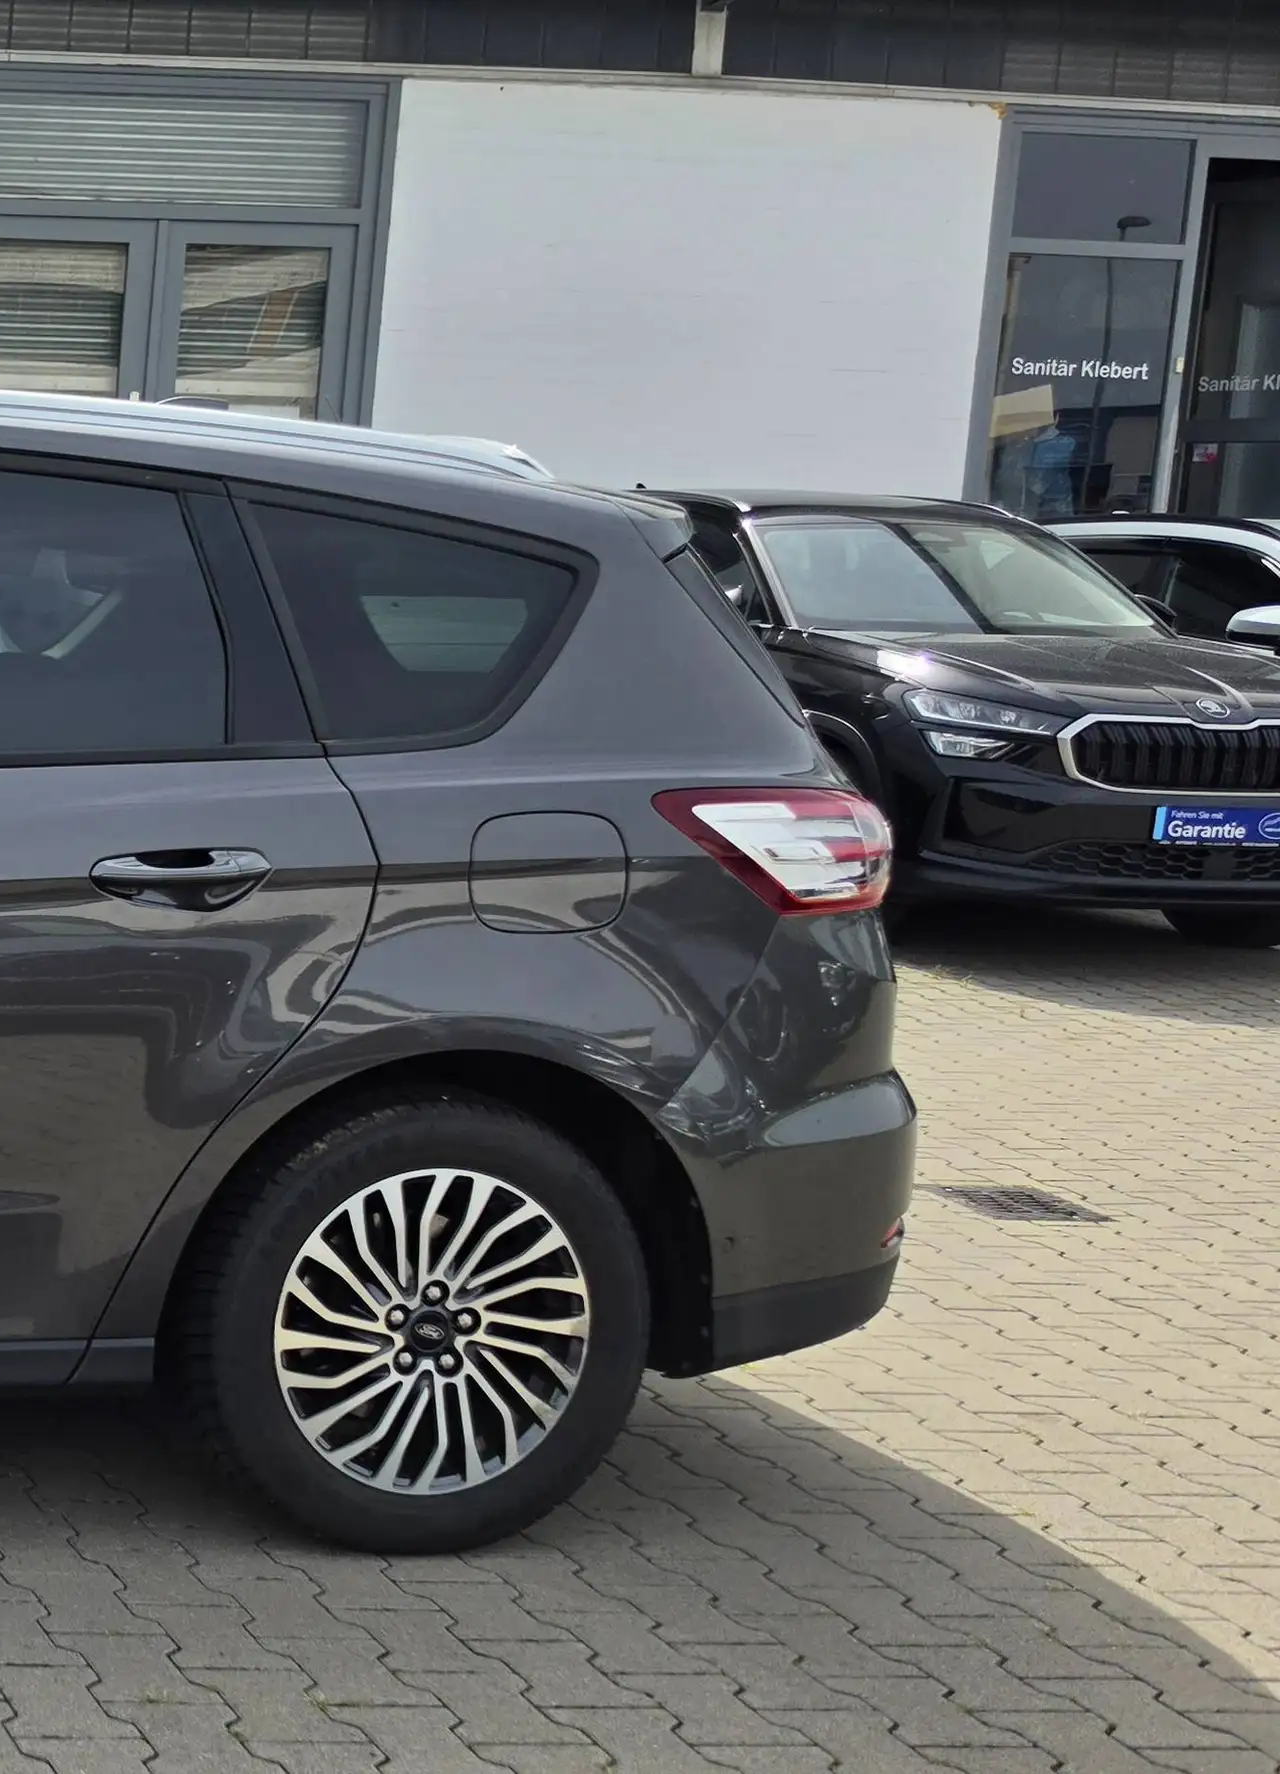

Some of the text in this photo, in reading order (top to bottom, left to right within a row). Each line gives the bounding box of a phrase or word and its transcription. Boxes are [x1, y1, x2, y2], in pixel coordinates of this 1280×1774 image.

[1012, 357, 1148, 380] Sanitär Klebert
[1198, 376, 1259, 392] Sanitär
[1171, 810, 1224, 820] Fahren Sie mit
[1167, 820, 1246, 839] Garantie
